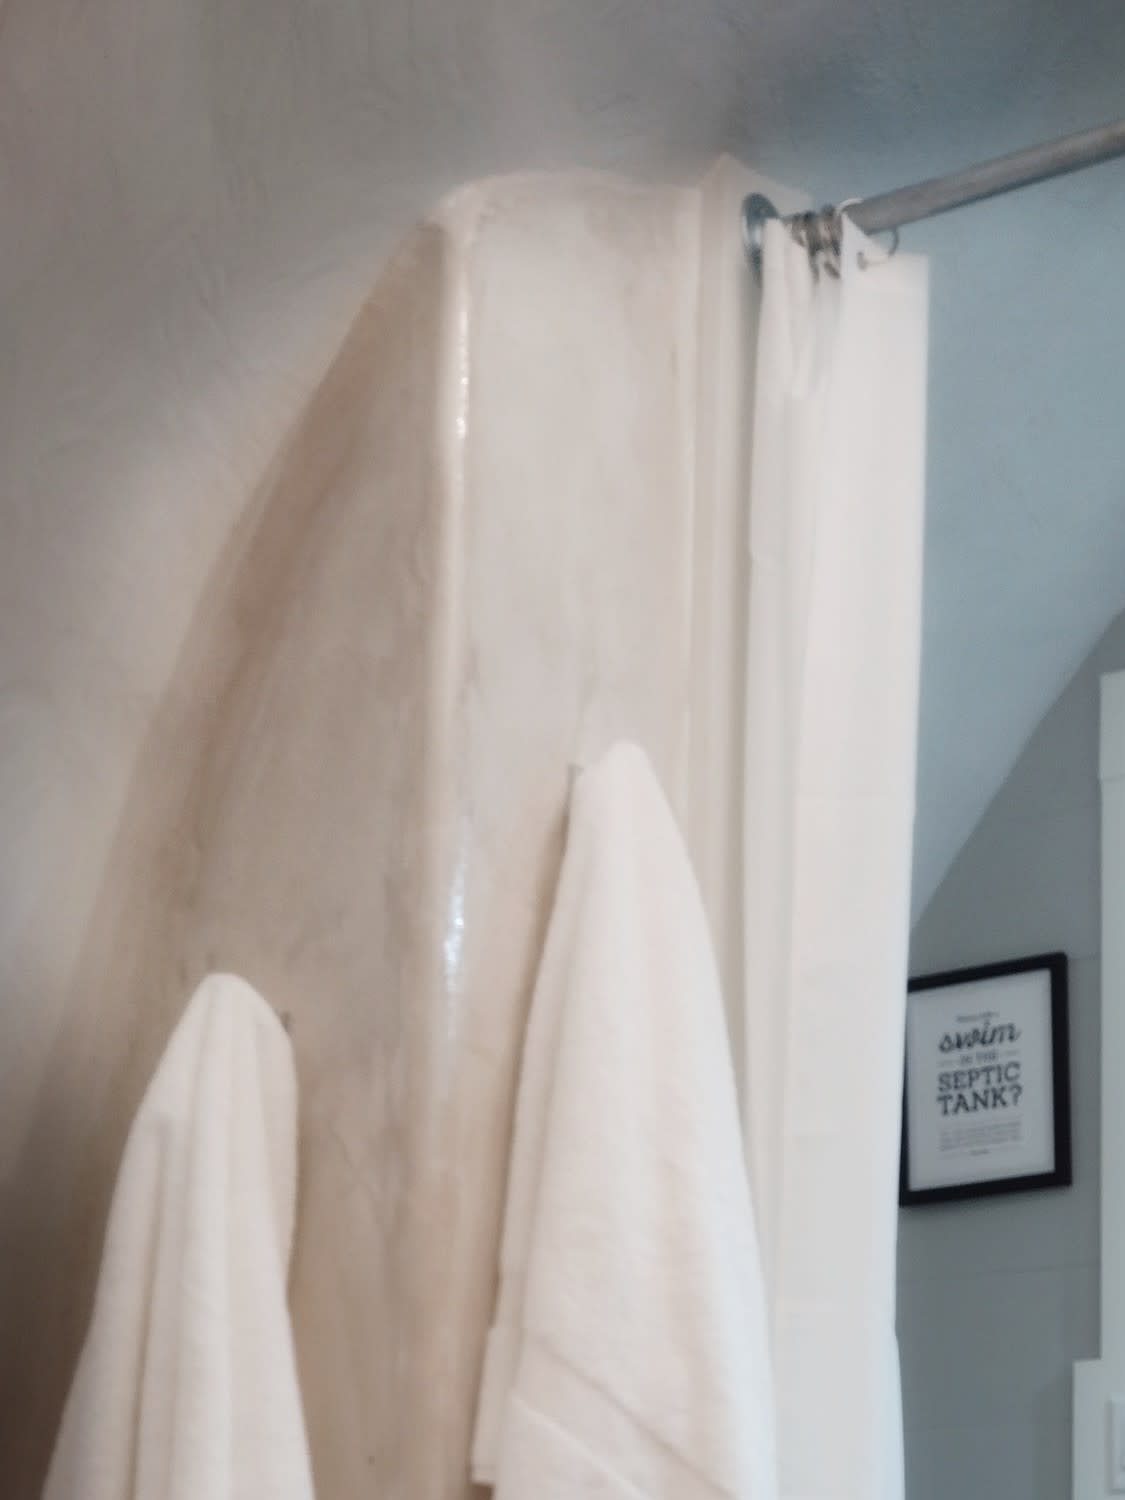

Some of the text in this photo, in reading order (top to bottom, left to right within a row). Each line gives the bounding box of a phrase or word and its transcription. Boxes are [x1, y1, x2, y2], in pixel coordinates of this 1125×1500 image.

[939, 1020, 1021, 1052] swim
[938, 1061, 1021, 1092] SEPTIC
[937, 1083, 1023, 1116] TANK?
